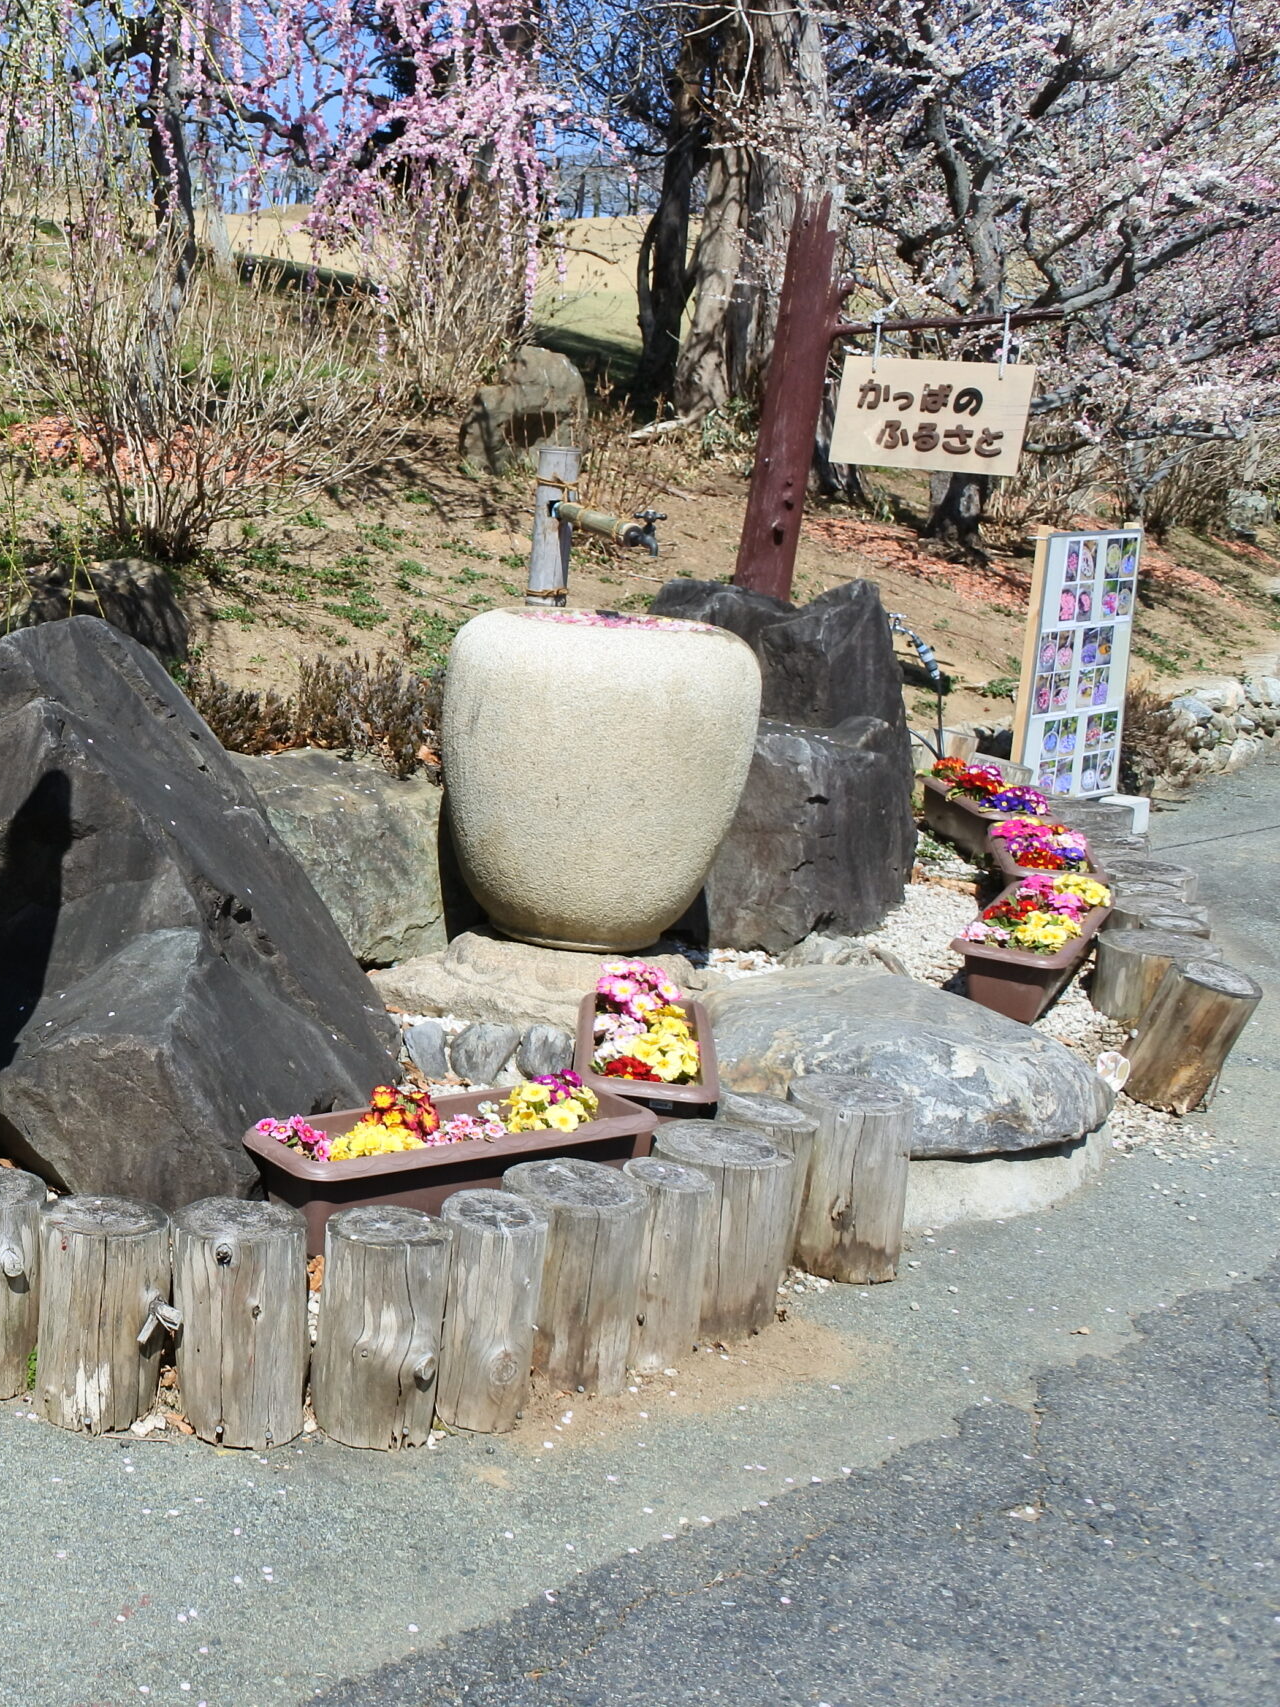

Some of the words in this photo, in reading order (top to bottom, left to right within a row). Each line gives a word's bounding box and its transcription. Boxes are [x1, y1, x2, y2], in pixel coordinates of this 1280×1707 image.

[857, 379, 984, 416] かっぱの
[875, 420, 1004, 458] ふるさと
